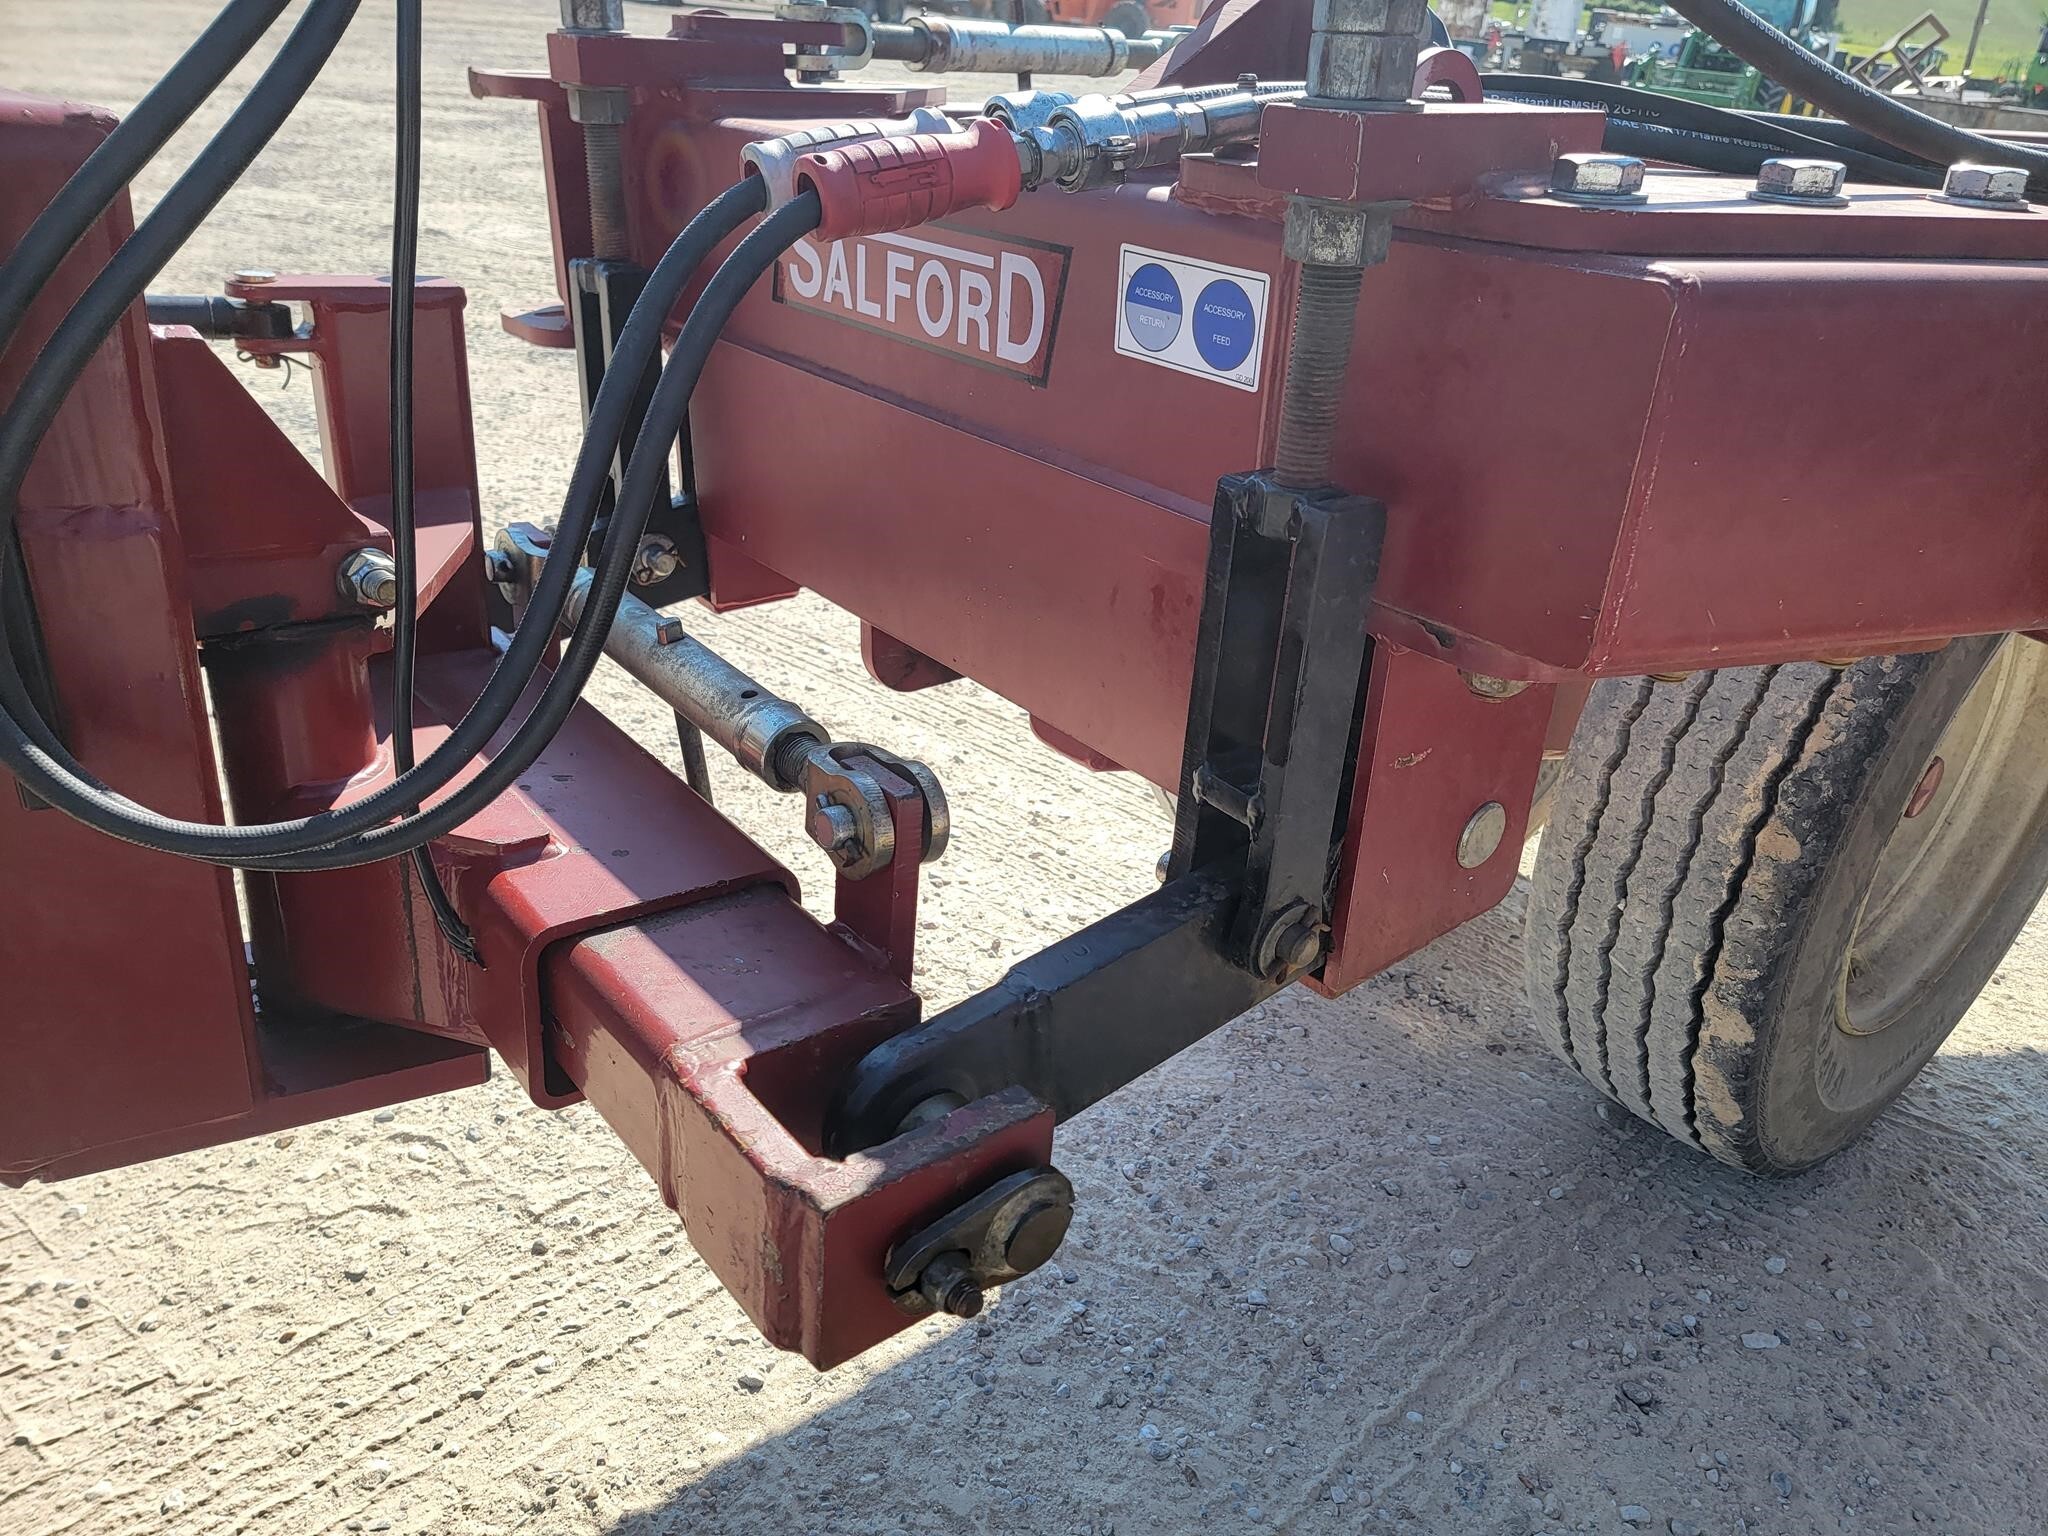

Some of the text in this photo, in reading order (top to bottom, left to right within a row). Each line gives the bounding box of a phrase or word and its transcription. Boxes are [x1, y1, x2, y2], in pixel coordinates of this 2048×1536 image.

[789, 238, 1045, 364] SALFORD
[1134, 287, 1174, 304] ACCESSORY
[1203, 303, 1247, 321] ACCESSORY
[1139, 314, 1166, 329] RETURN
[1212, 333, 1231, 346] FEED
